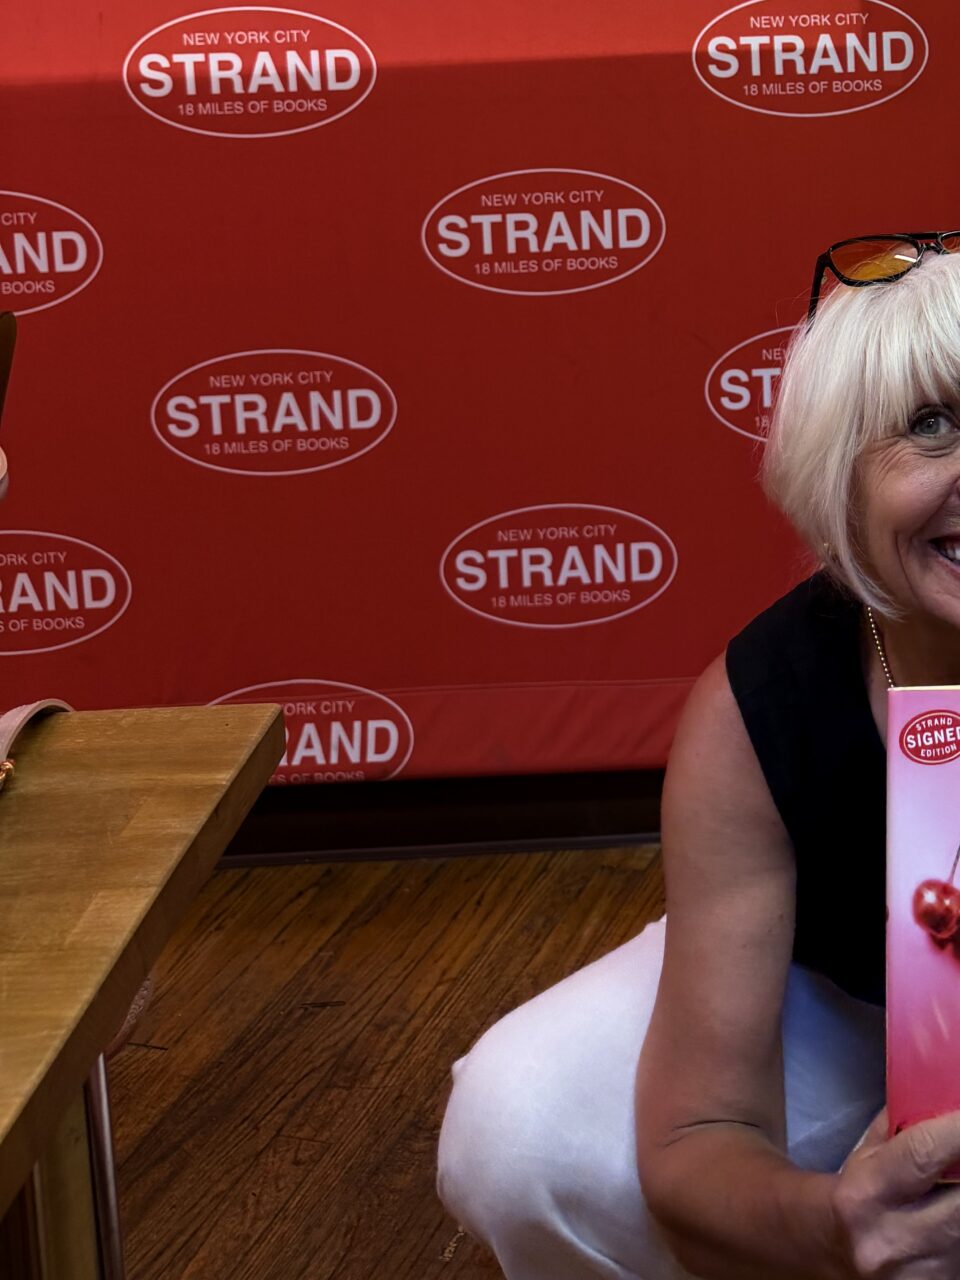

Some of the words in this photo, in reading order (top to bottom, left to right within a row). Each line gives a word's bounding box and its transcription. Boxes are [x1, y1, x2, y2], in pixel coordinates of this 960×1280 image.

[750, 16, 784, 28] NEW
[789, 14, 831, 27] YORK
[835, 13, 868, 25] CITY
[183, 33, 219, 45] NEW
[224, 31, 269, 44] YORK
[274, 30, 310, 43] CITY
[707, 31, 914, 78] STRAND
[139, 49, 360, 97] STRAND
[744, 84, 758, 95] 18
[763, 82, 804, 94] MILES
[809, 81, 828, 93] OF
[833, 79, 882, 92] BOOKS
[179, 104, 195, 115] 18
[199, 102, 243, 115] MILES
[248, 101, 267, 113] OF
[274, 99, 327, 112] BOOKS
[481, 194, 517, 206] NEW
[522, 192, 565, 205] YORK
[569, 190, 604, 203] CITY
[1, 212, 37, 226] CITY
[438, 208, 650, 257] STRAND
[475, 263, 490, 274] 18
[494, 260, 538, 273] MILES
[542, 259, 562, 271] OF
[567, 257, 617, 270] BOOKS
[1, 280, 55, 295] BOOKS
[762, 348, 787, 361] NE
[210, 375, 245, 387] NEW
[250, 373, 293, 386] YORK
[298, 371, 332, 384] CITY
[167, 389, 381, 437] STRAND
[205, 443, 220, 454] 18
[224, 440, 268, 453] MILES
[272, 439, 292, 452] OF
[297, 437, 348, 450] BOOKS
[498, 529, 532, 541] NEW
[538, 527, 578, 539] YORK
[583, 525, 616, 537] CITY
[32, 551, 67, 565] CITY
[455, 542, 662, 591] STRAND
[0, 568, 116, 613] AND
[492, 596, 506, 607] 18
[510, 594, 552, 606] MILES
[557, 592, 575, 604] OF
[581, 590, 630, 602] BOOKS
[8, 619, 29, 632] OF
[33, 616, 85, 631] BOOKS
[281, 702, 317, 716] ORK
[320, 700, 356, 714] CITY
[915, 717, 953, 731] STRAND
[279, 720, 399, 766] AND
[920, 744, 957, 757] EDITION
